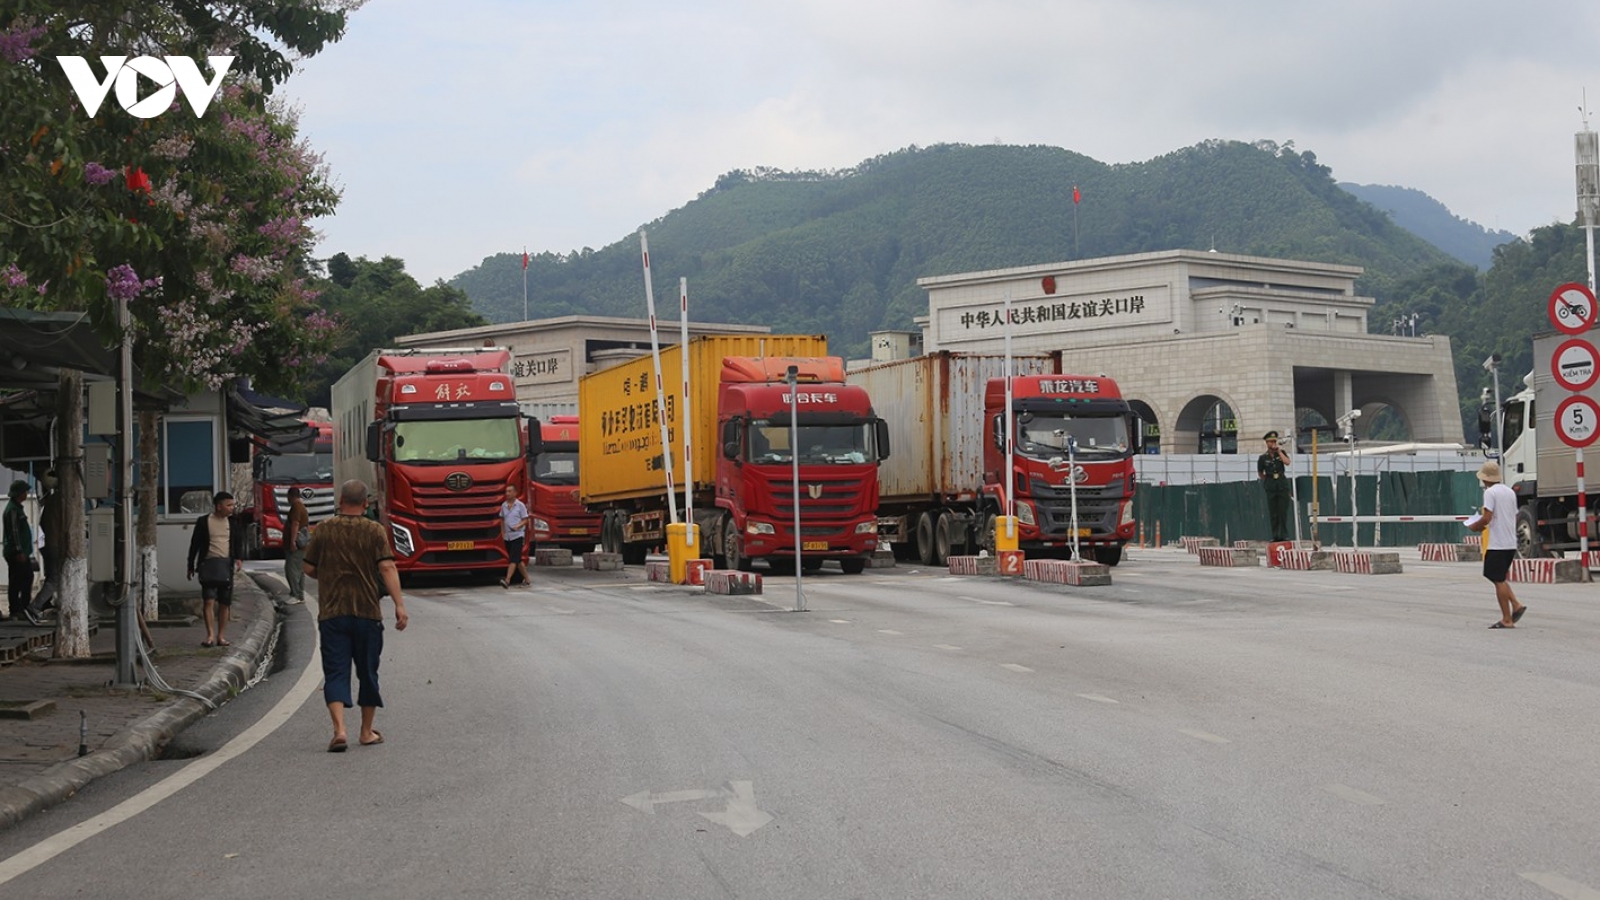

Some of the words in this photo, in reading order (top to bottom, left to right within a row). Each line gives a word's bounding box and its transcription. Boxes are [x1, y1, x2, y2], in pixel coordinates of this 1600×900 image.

[961, 296, 1144, 329] 中华人民共和国友谊关口岸
[1573, 409, 1583, 425] 5
[1007, 555, 1018, 571] 2
[697, 564, 704, 581] 1
